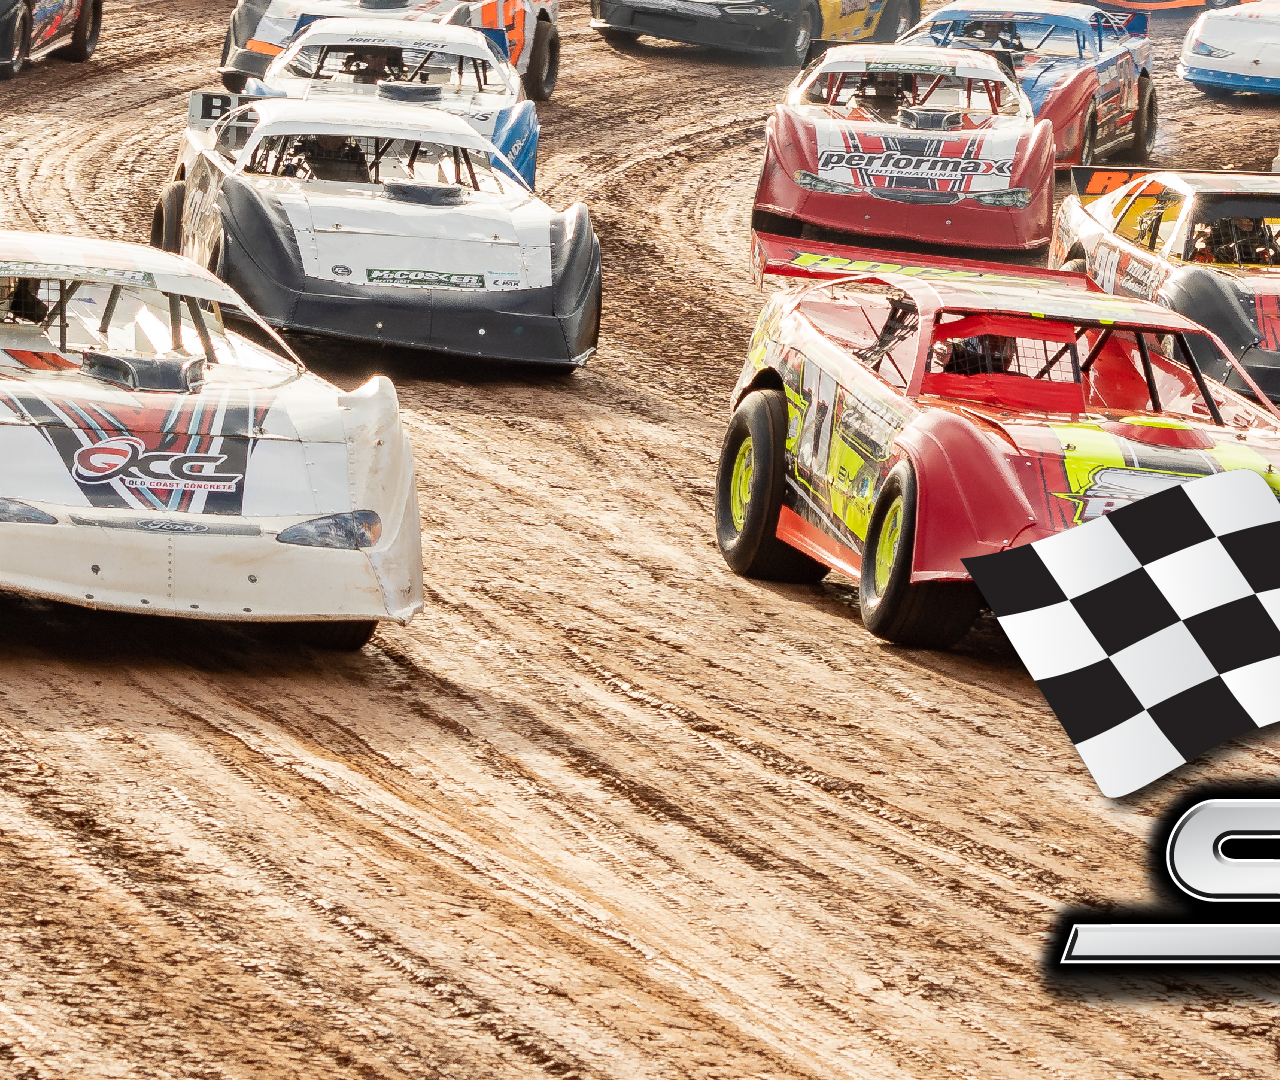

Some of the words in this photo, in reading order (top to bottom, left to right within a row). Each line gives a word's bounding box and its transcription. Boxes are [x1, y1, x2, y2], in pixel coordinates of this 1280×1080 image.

[821, 151, 1011, 175] performax
[870, 169, 962, 179] INTERNATIONAL
[128, 479, 146, 487] QLD
[149, 480, 181, 489] COAST
[183, 482, 234, 491] CONCRETE
[147, 520, 200, 533] Ford
